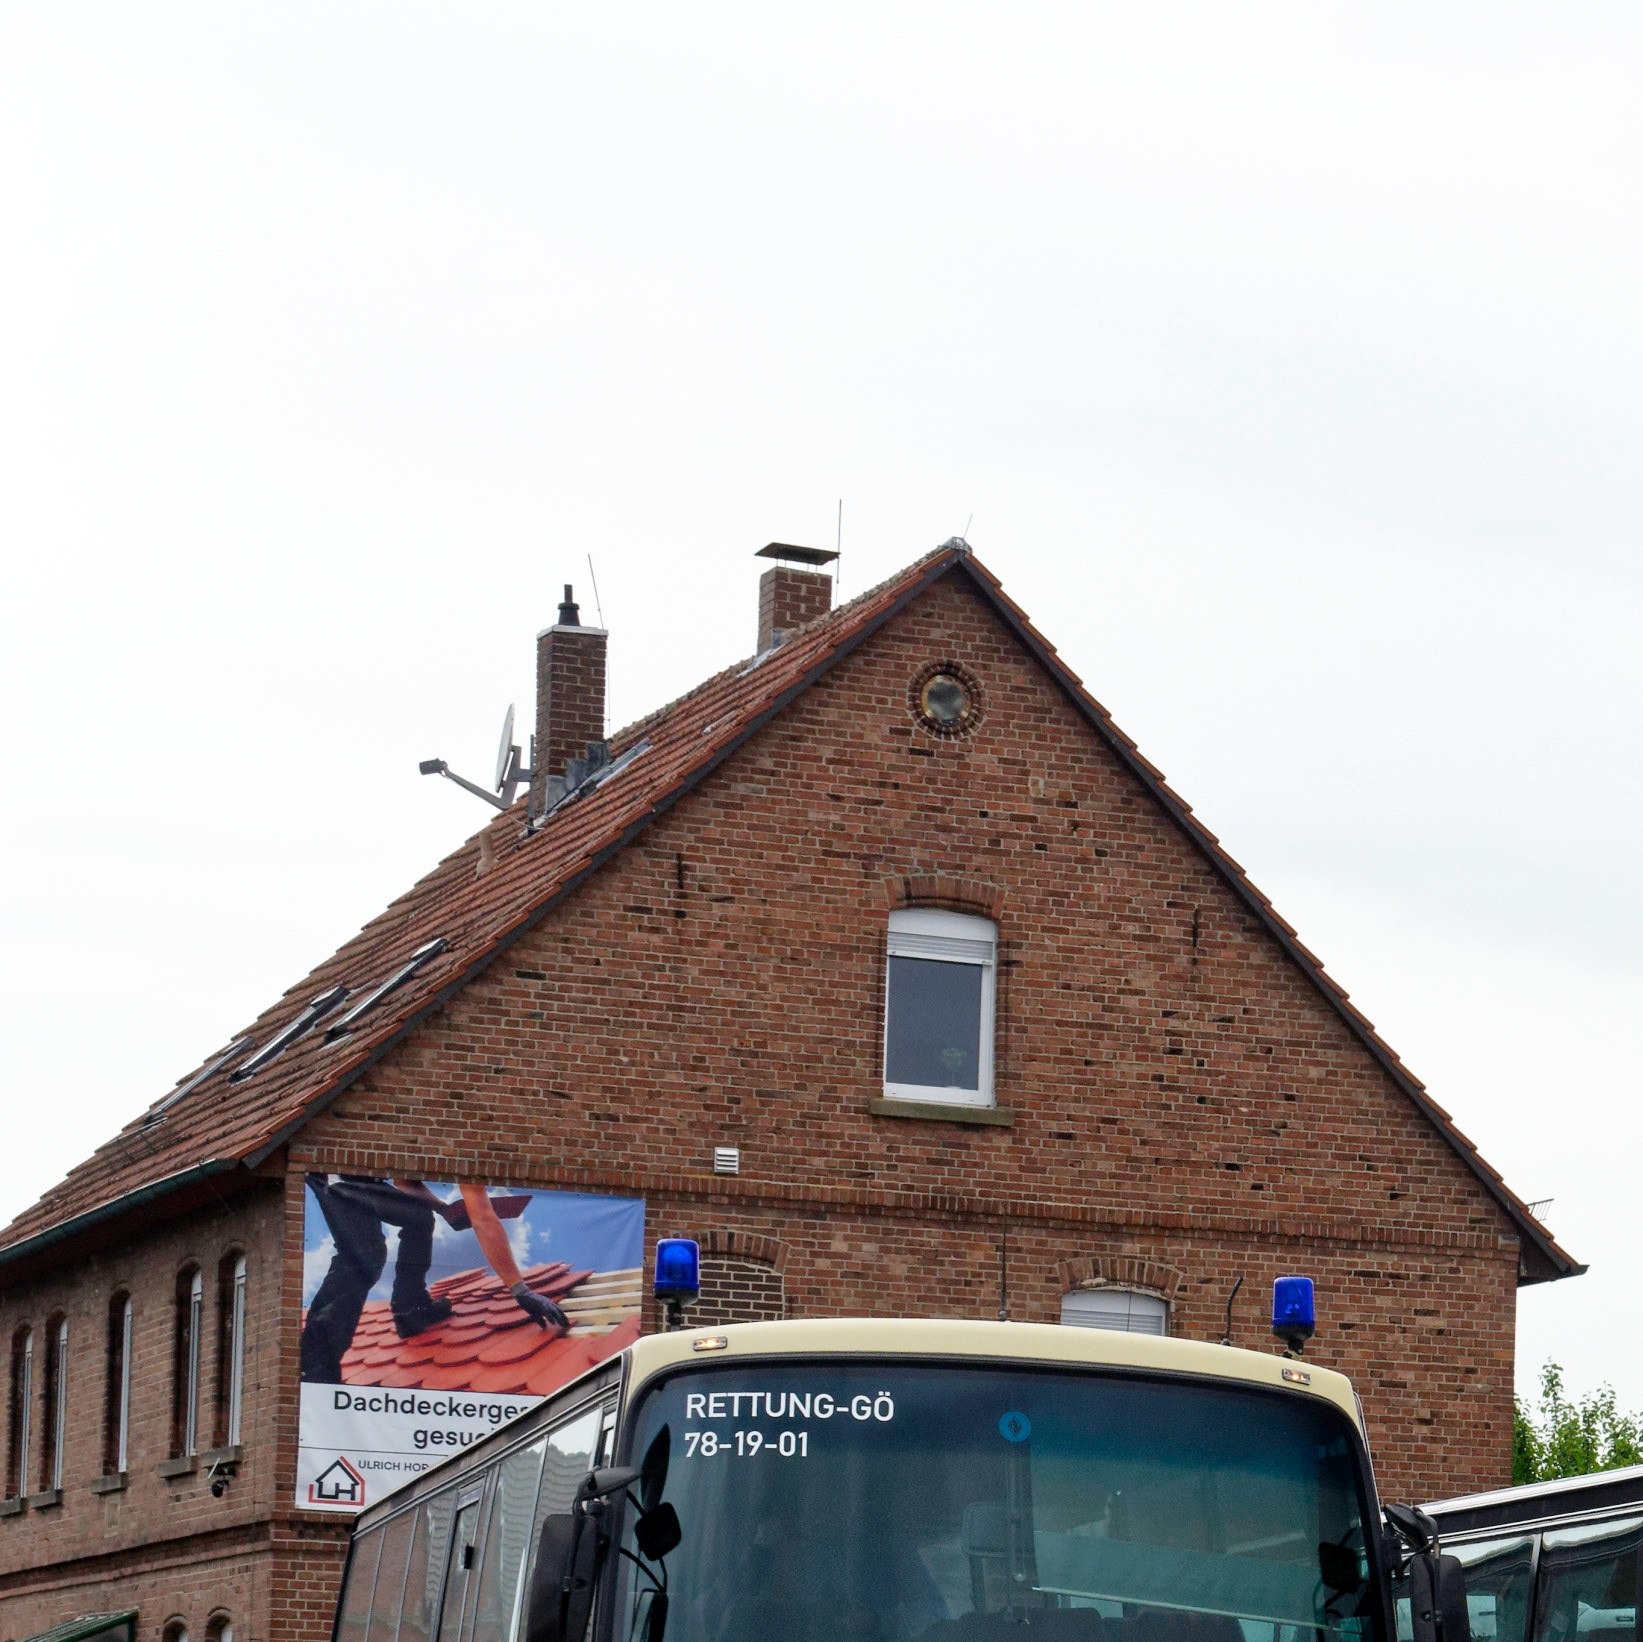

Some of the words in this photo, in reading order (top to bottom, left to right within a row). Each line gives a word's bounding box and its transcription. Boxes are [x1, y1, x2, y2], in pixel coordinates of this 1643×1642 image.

[686, 1391, 894, 1422] RETTUNG-GÖ
[684, 1431, 808, 1457] 78-19-01
[358, 1460, 400, 1471] ULRICH
